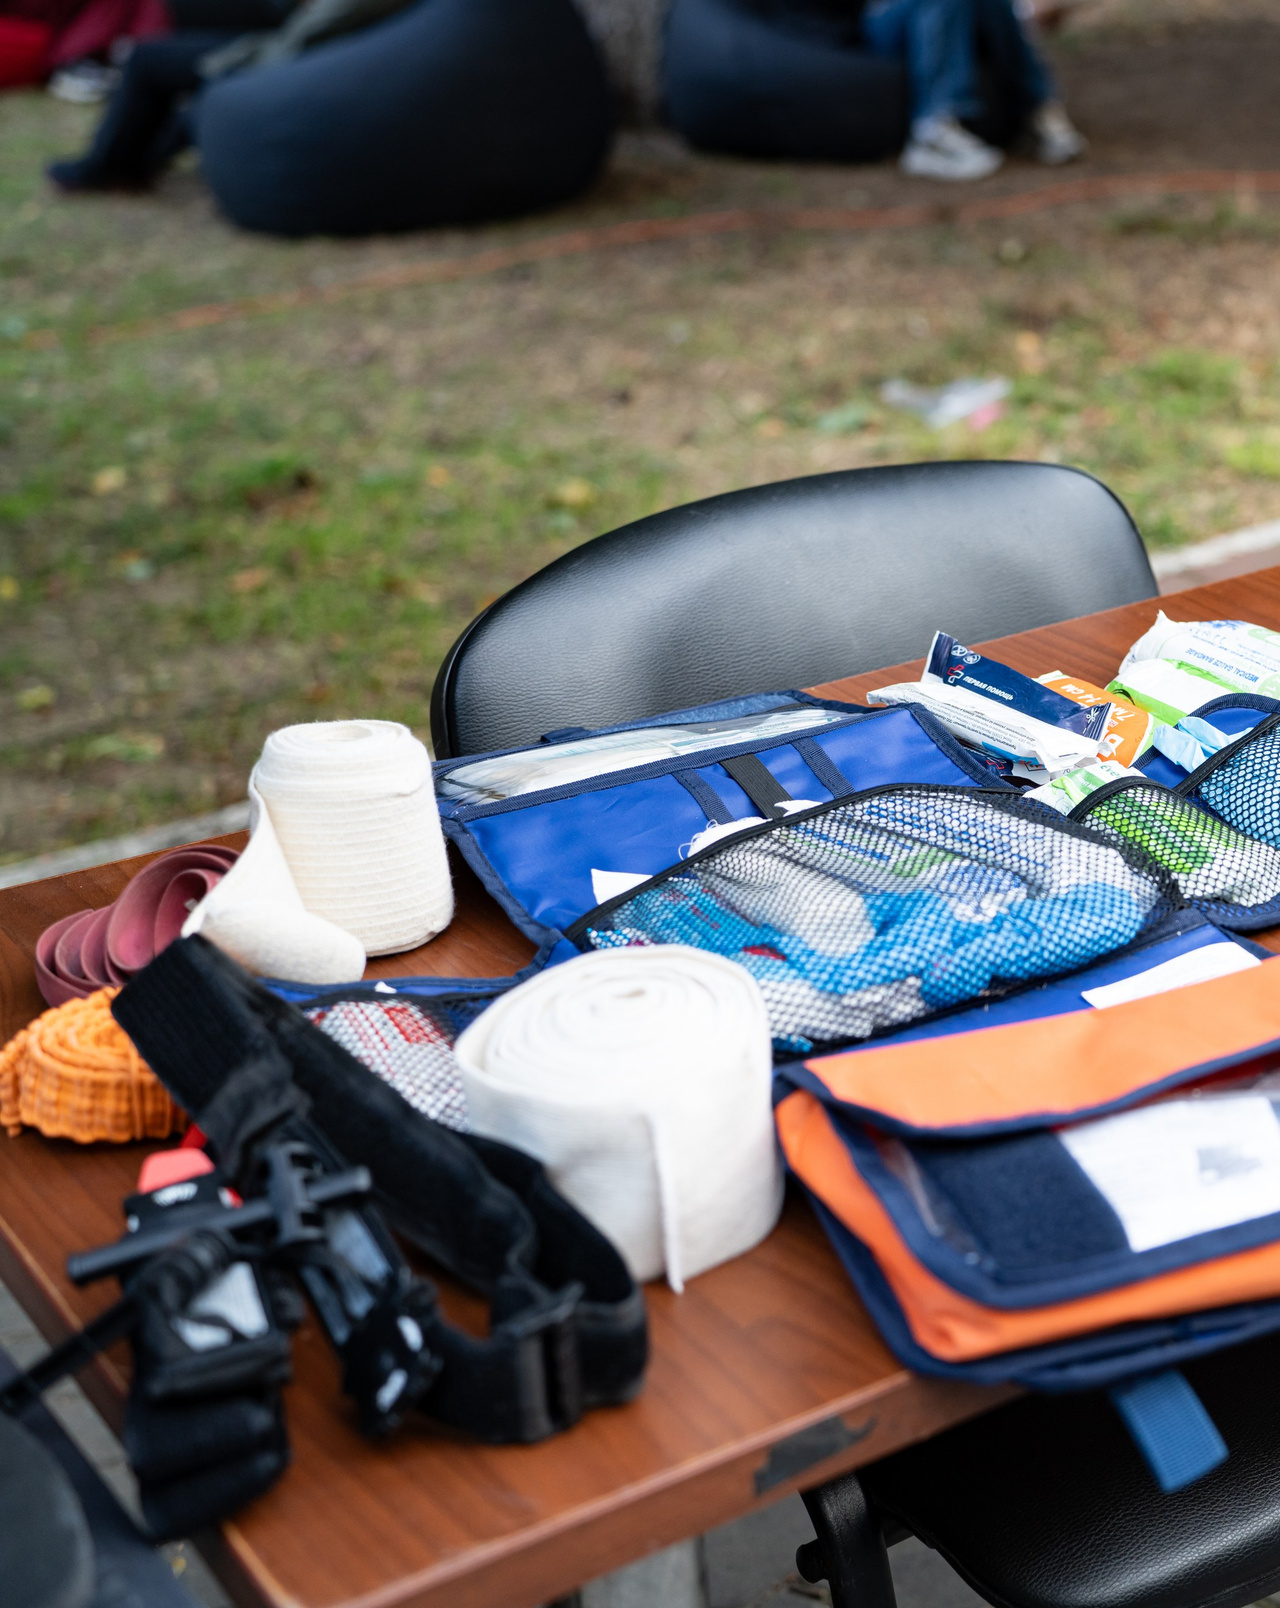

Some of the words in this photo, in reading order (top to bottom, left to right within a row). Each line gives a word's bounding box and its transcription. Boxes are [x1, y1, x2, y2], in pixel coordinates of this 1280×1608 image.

[1185, 647, 1214, 664] BANDAGE
[1213, 659, 1234, 673] GAUZE
[1233, 667, 1260, 683] MEDICAL
[962, 675, 988, 692] ПЕРВАЯ
[985, 685, 1014, 701] ПОМОЩЬ
